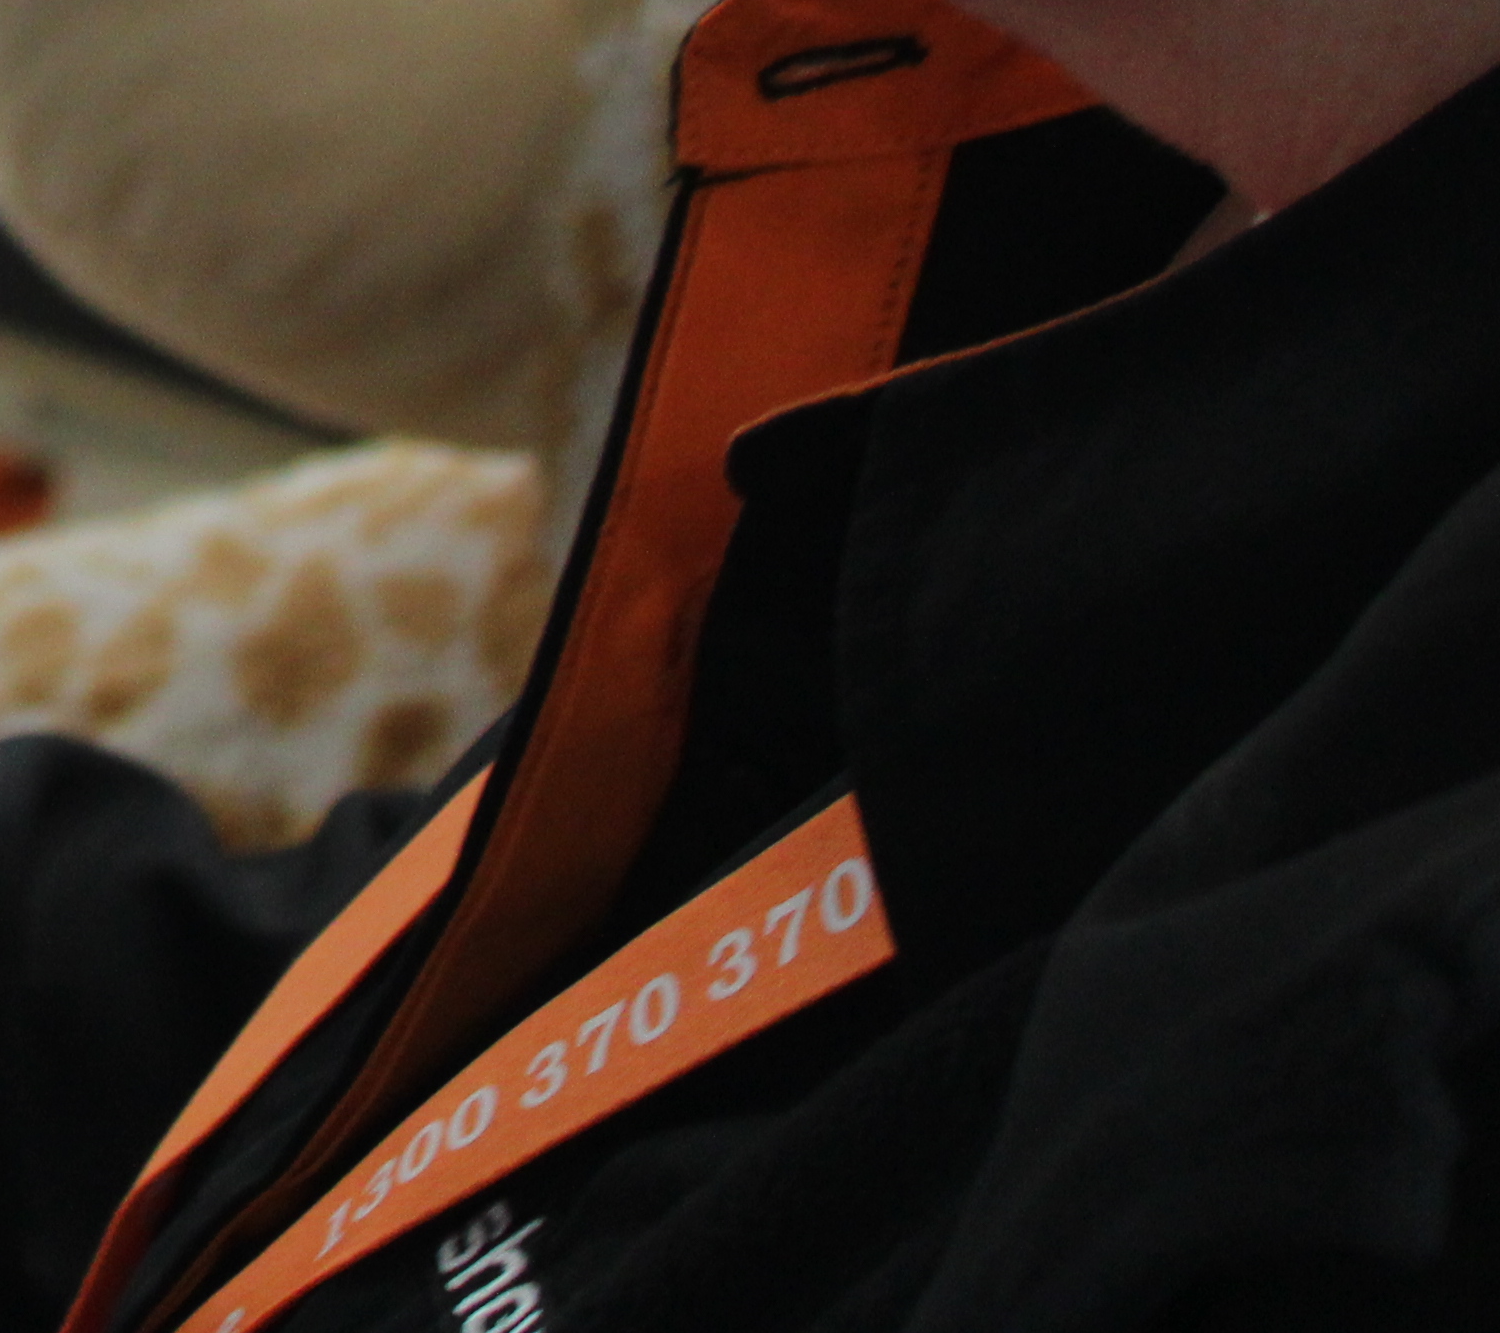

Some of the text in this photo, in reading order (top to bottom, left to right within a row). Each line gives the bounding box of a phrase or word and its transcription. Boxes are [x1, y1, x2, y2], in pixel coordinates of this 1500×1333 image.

[313, 855, 874, 1260] 1300 370 370
